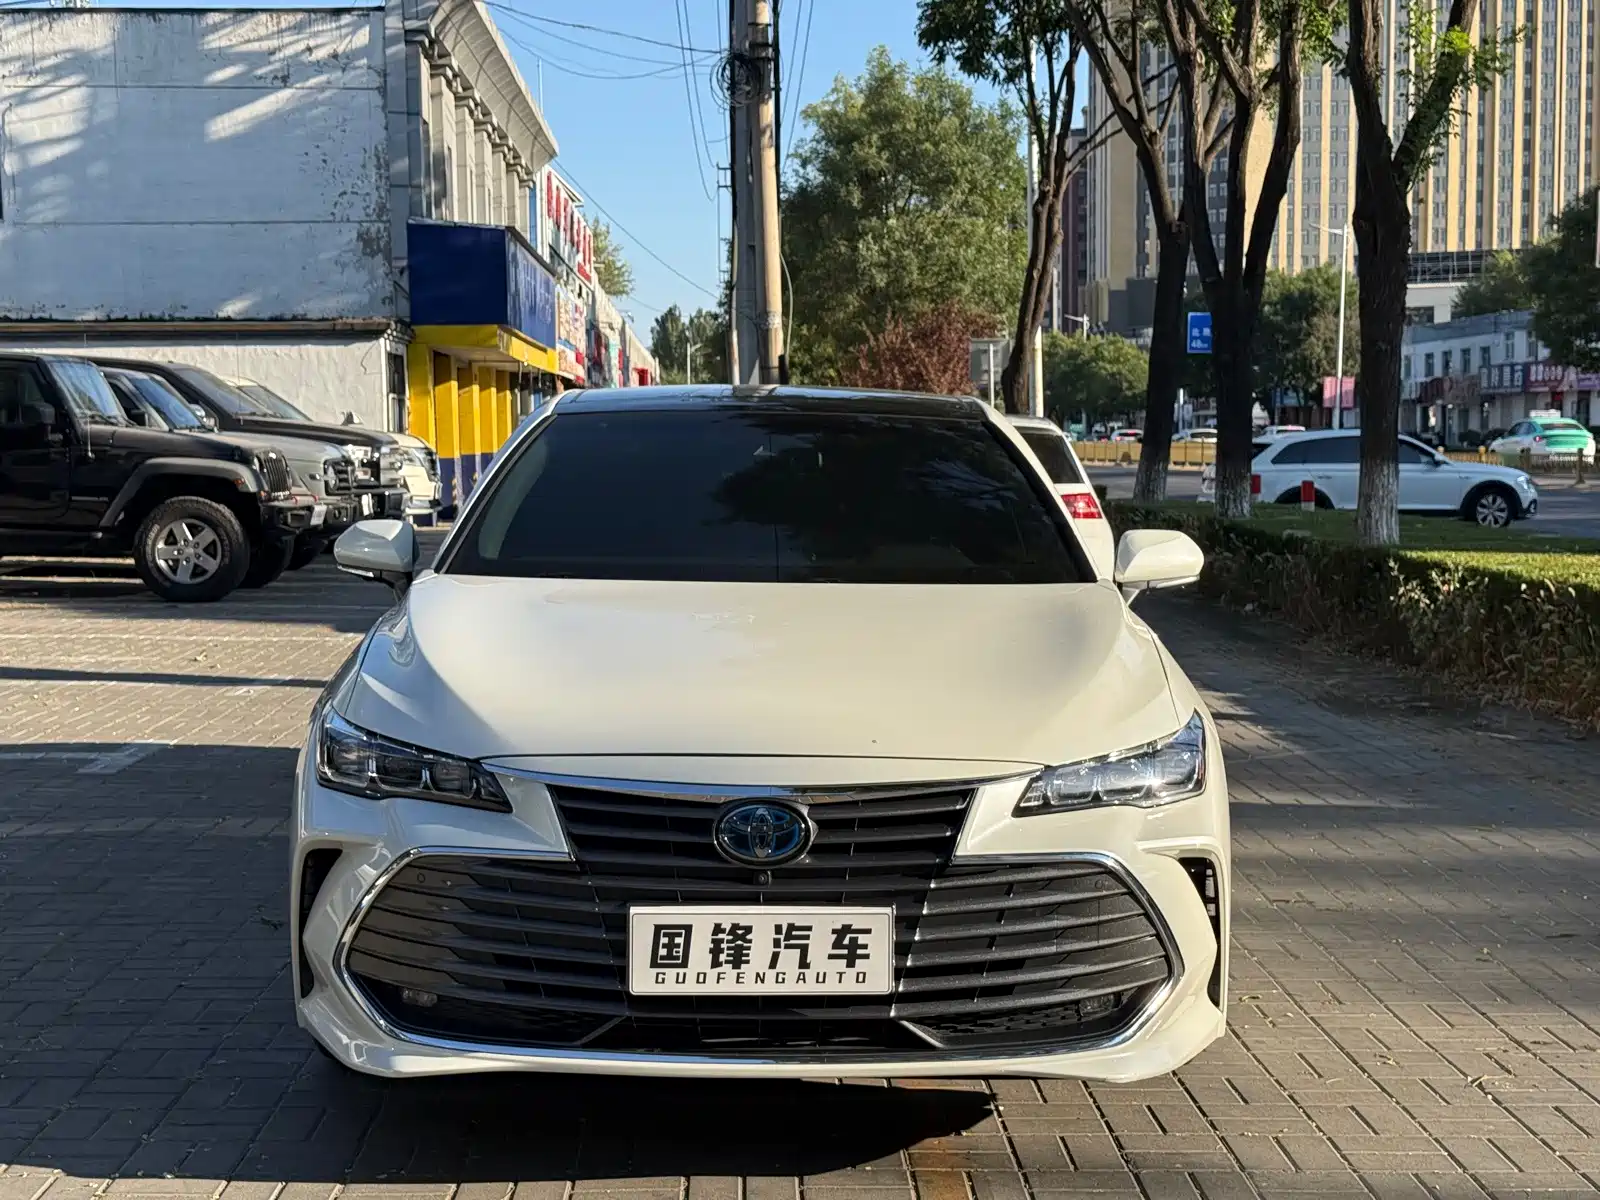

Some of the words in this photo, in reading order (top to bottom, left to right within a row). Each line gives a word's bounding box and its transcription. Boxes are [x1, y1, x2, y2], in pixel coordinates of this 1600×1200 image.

[649, 922, 873, 970] 国锋汽车
[654, 971, 867, 984] GUOFENGAUTO
